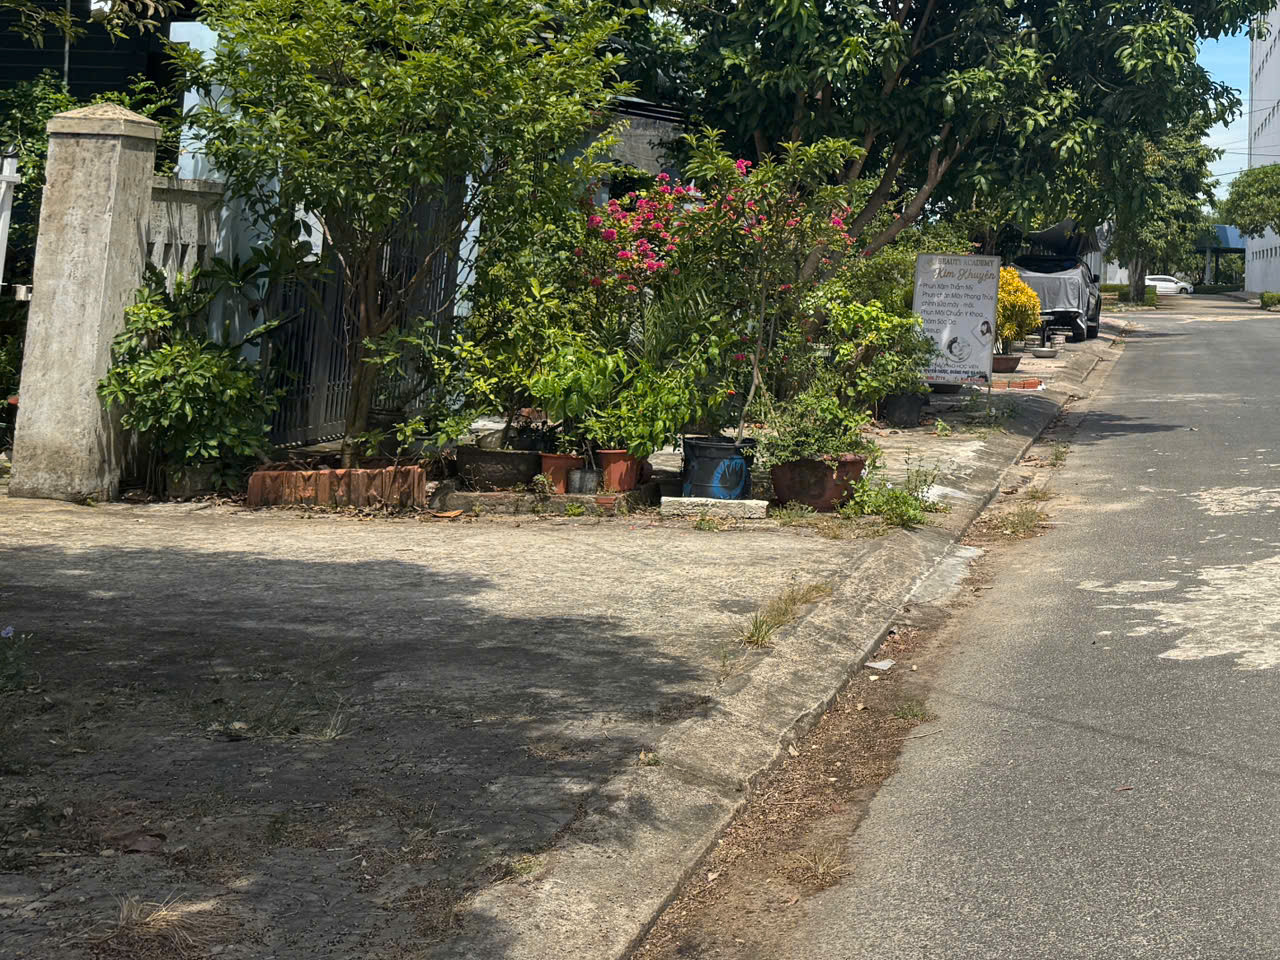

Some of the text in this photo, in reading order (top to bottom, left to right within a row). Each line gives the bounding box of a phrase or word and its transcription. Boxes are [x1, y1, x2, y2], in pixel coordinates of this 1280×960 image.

[963, 258, 995, 267] ACADEMY
[933, 268, 955, 280] Kim
[922, 282, 937, 290] Phun
